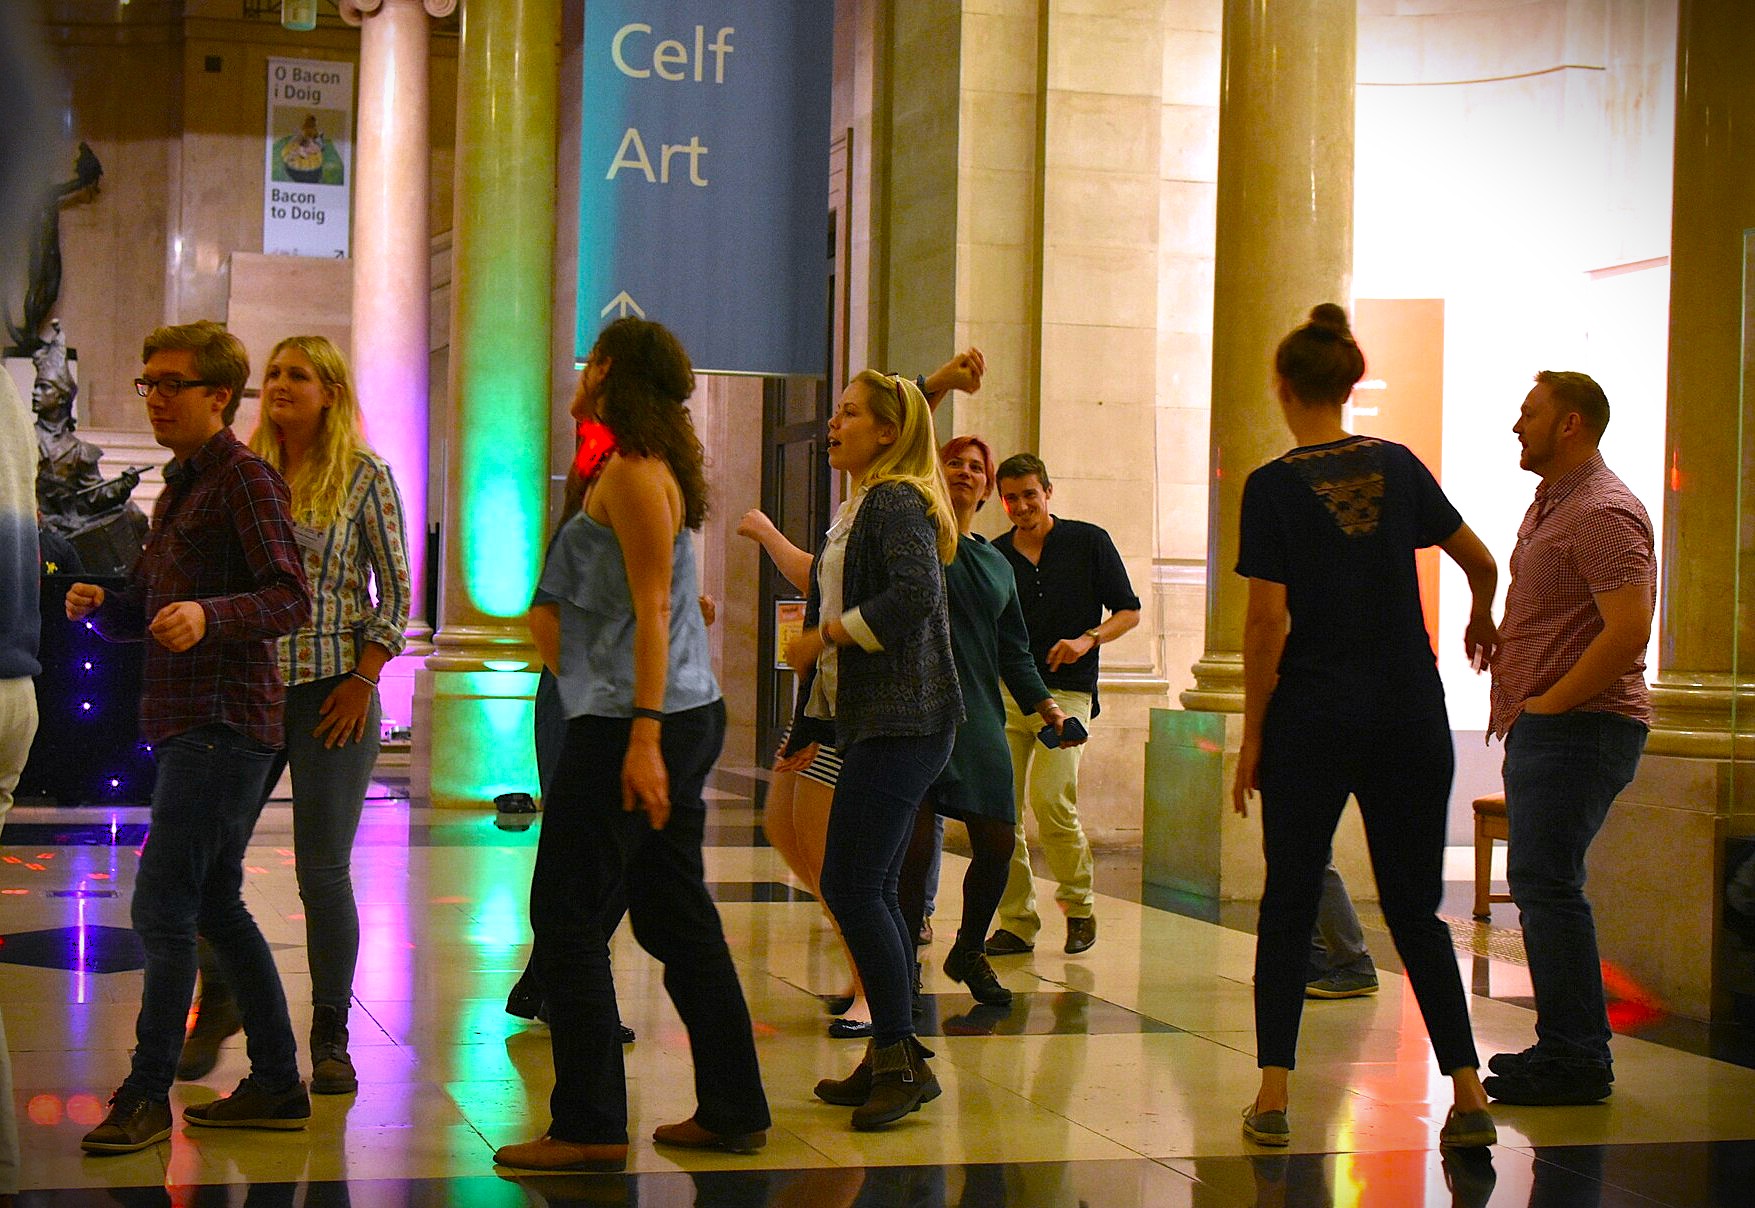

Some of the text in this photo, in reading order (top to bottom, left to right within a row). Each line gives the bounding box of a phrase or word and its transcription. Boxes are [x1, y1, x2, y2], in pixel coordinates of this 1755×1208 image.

[611, 23, 735, 84] Celf
[275, 66, 340, 84] O Bacon
[275, 84, 322, 105] i Doig
[605, 127, 709, 187] Art
[272, 188, 316, 204] Bacon
[271, 206, 325, 225] to Doig
